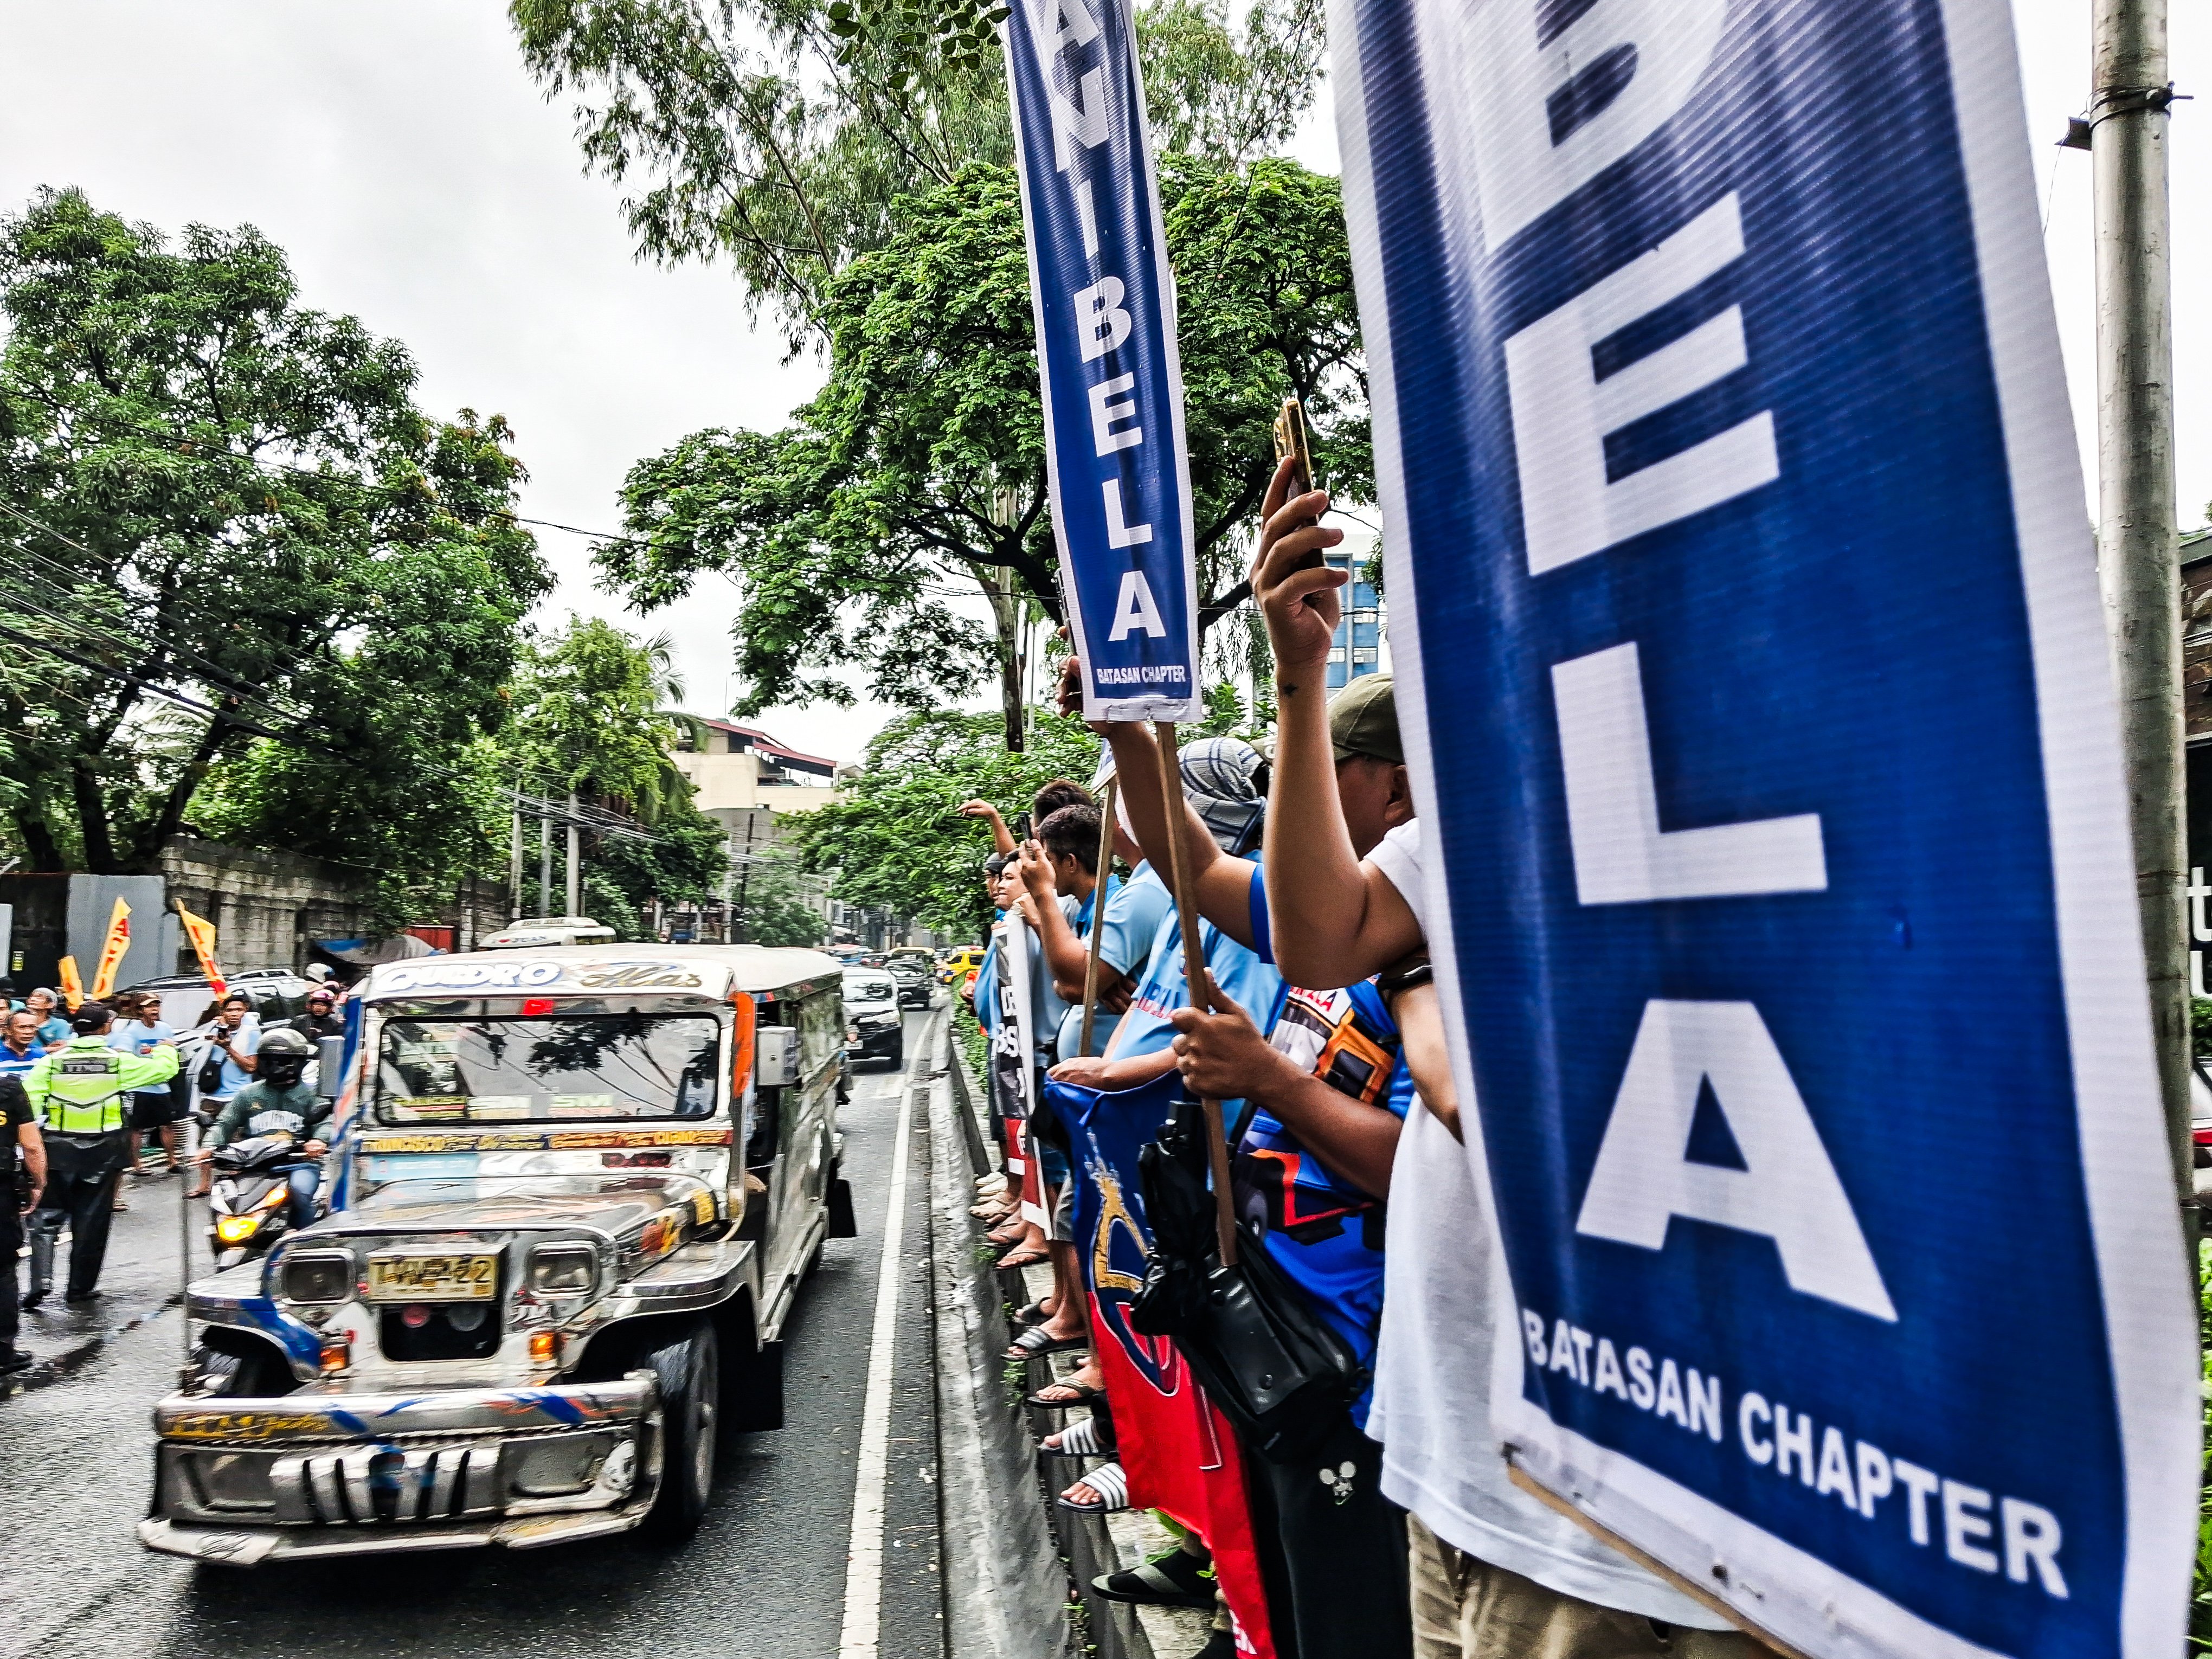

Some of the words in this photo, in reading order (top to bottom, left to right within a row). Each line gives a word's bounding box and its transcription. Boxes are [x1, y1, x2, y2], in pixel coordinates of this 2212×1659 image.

[1096, 667, 1141, 684] BATASAN
[1141, 665, 1186, 683] CHAPTER
[1522, 1308, 1722, 1442] BATASAN
[1738, 1391, 2068, 1599] CHAPTER
